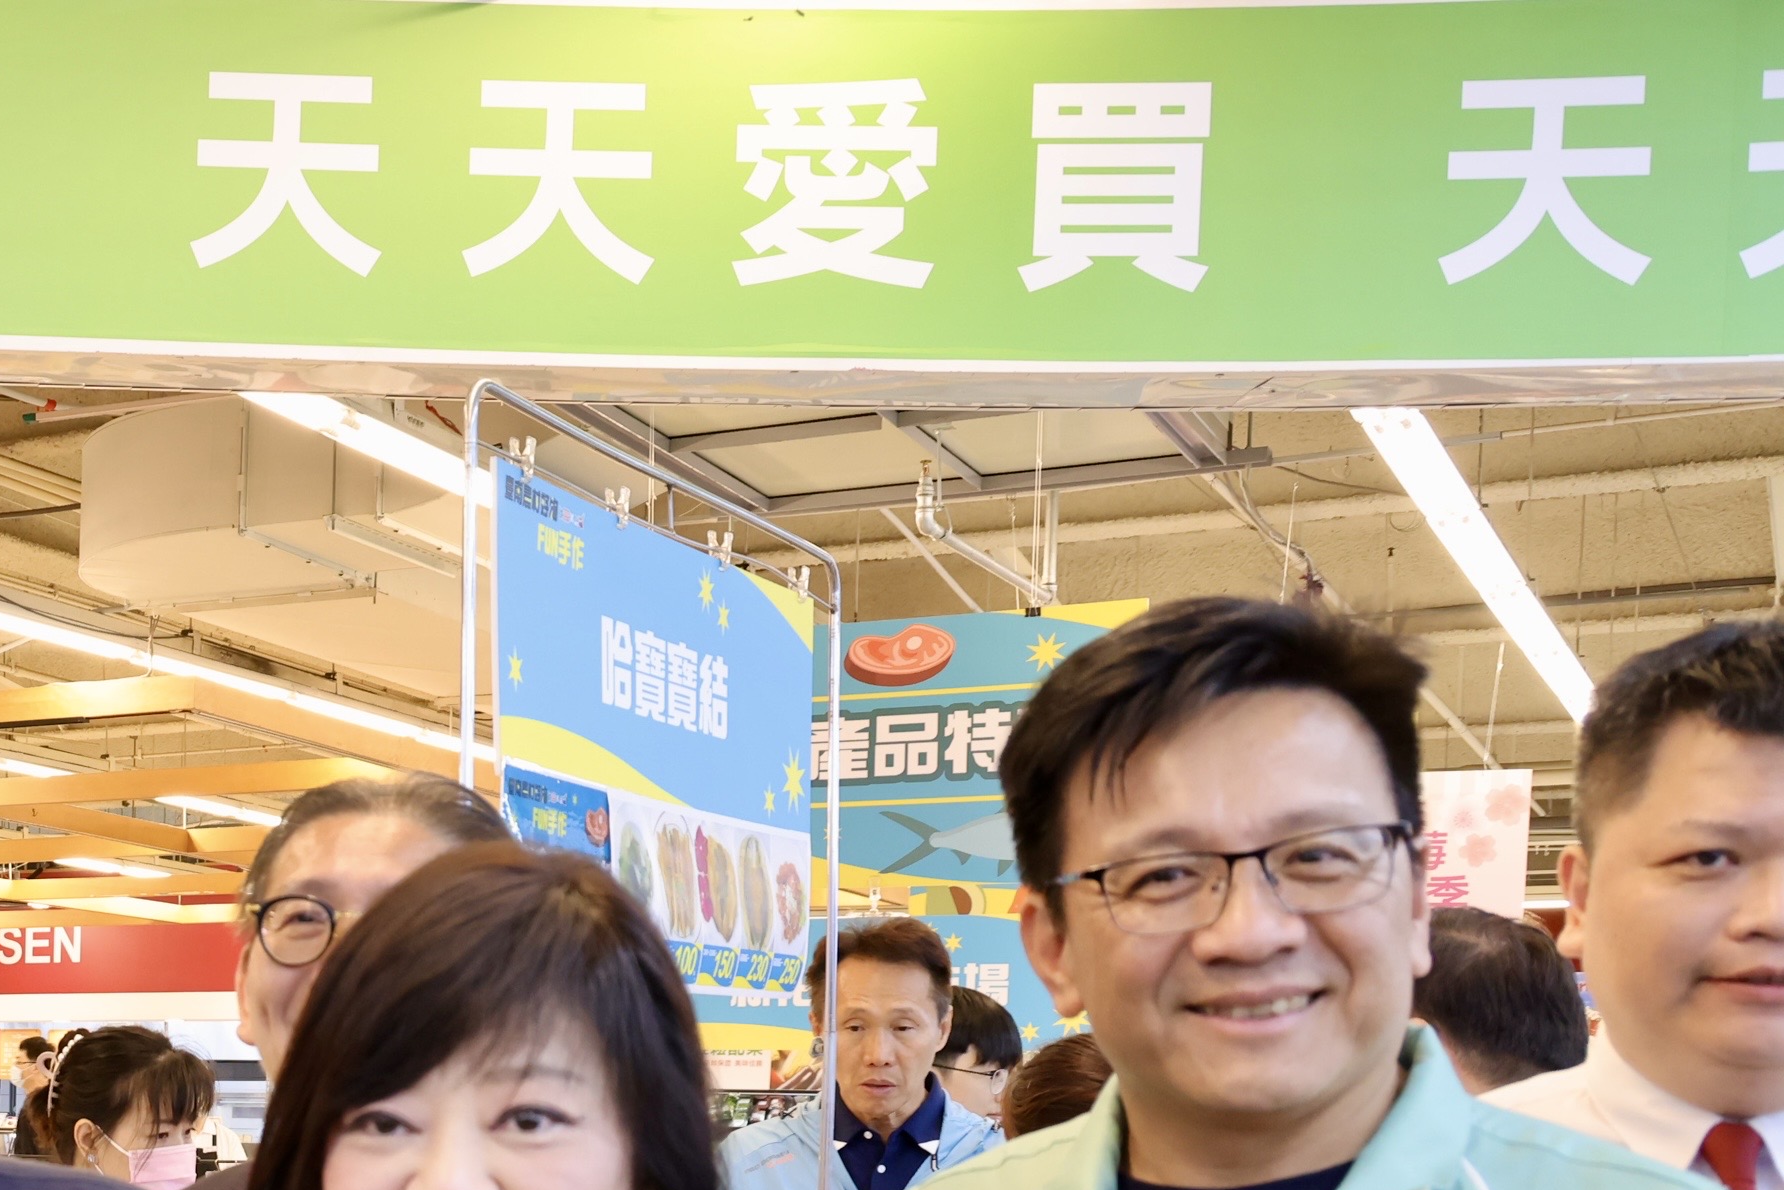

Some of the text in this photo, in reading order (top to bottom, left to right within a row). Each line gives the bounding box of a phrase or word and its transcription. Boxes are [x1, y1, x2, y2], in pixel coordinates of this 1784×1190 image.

[189, 69, 1784, 292] 天天愛買 天
[713, 950, 736, 979] 150
[747, 955, 770, 982] 230
[779, 958, 801, 985] 250
